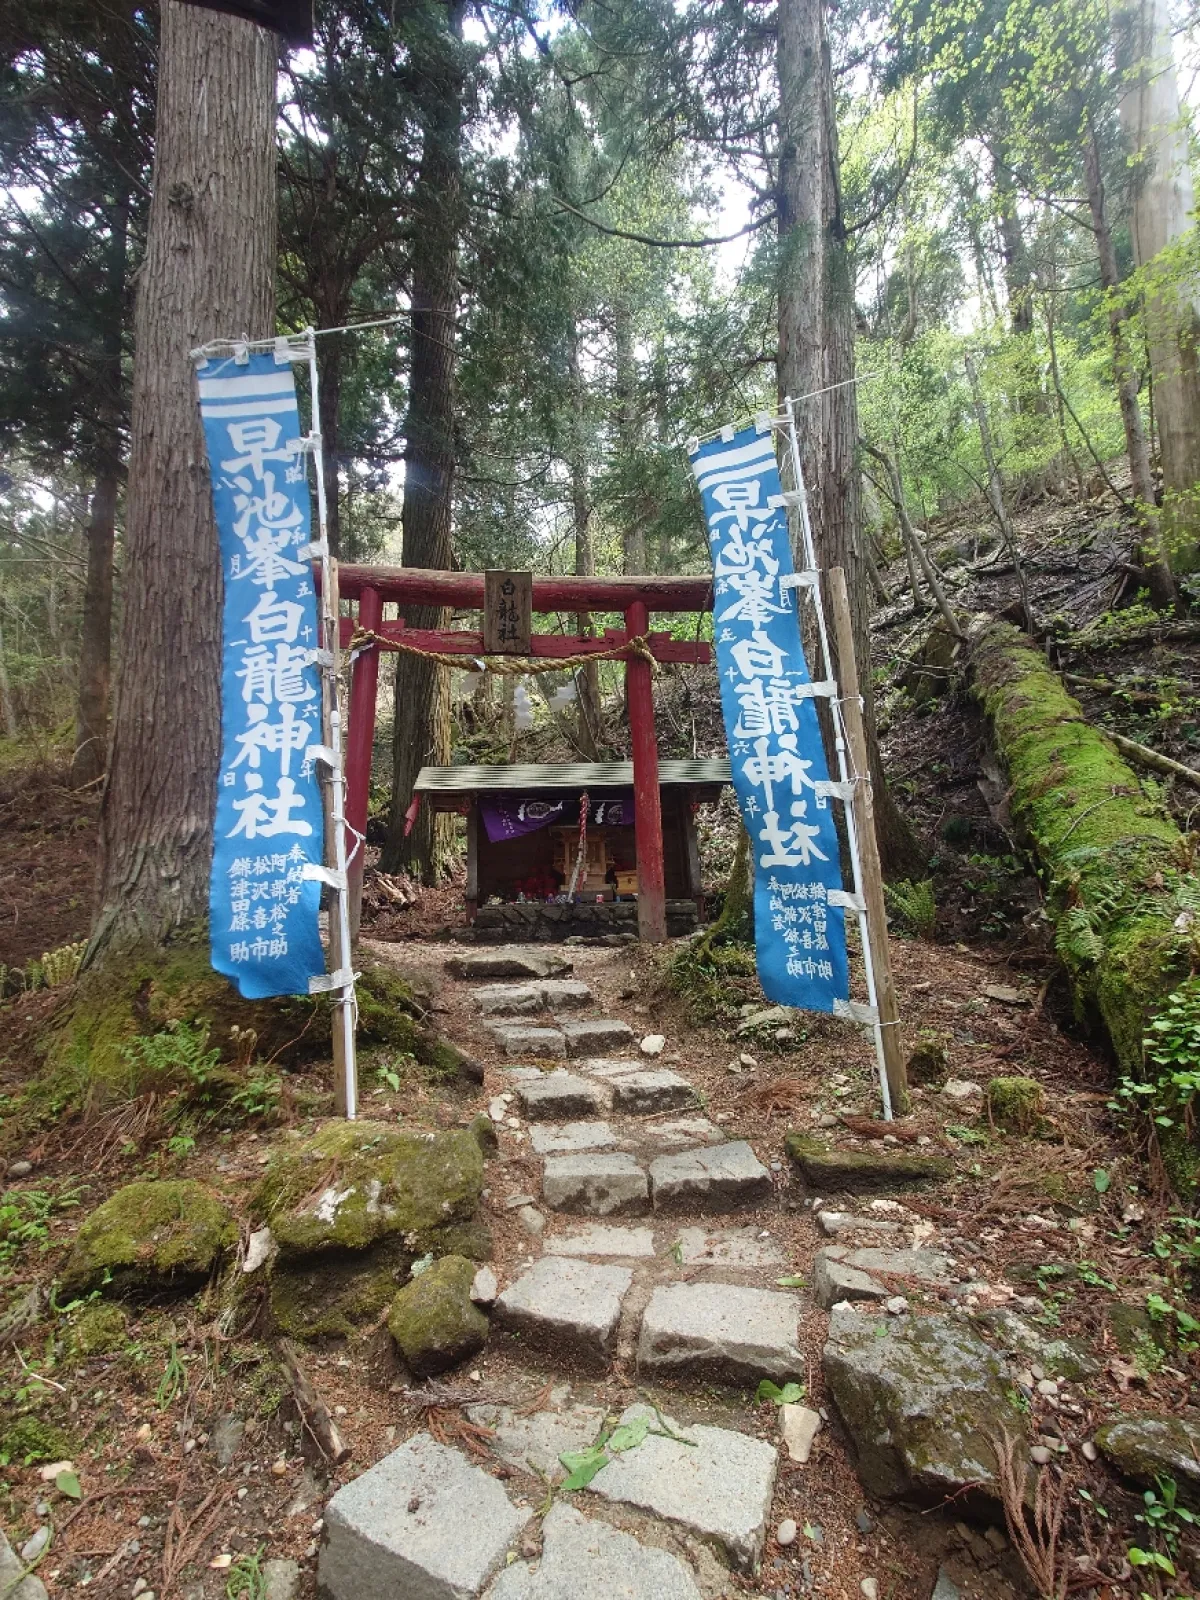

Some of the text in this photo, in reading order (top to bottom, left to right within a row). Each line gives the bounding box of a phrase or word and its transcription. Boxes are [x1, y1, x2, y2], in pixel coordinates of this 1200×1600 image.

[220, 417, 317, 839] 早池峯白龍神社
[250, 856, 271, 962] 松沢喜市
[268, 854, 290, 960] 阿部松之助
[285, 843, 307, 905] 奉納者
